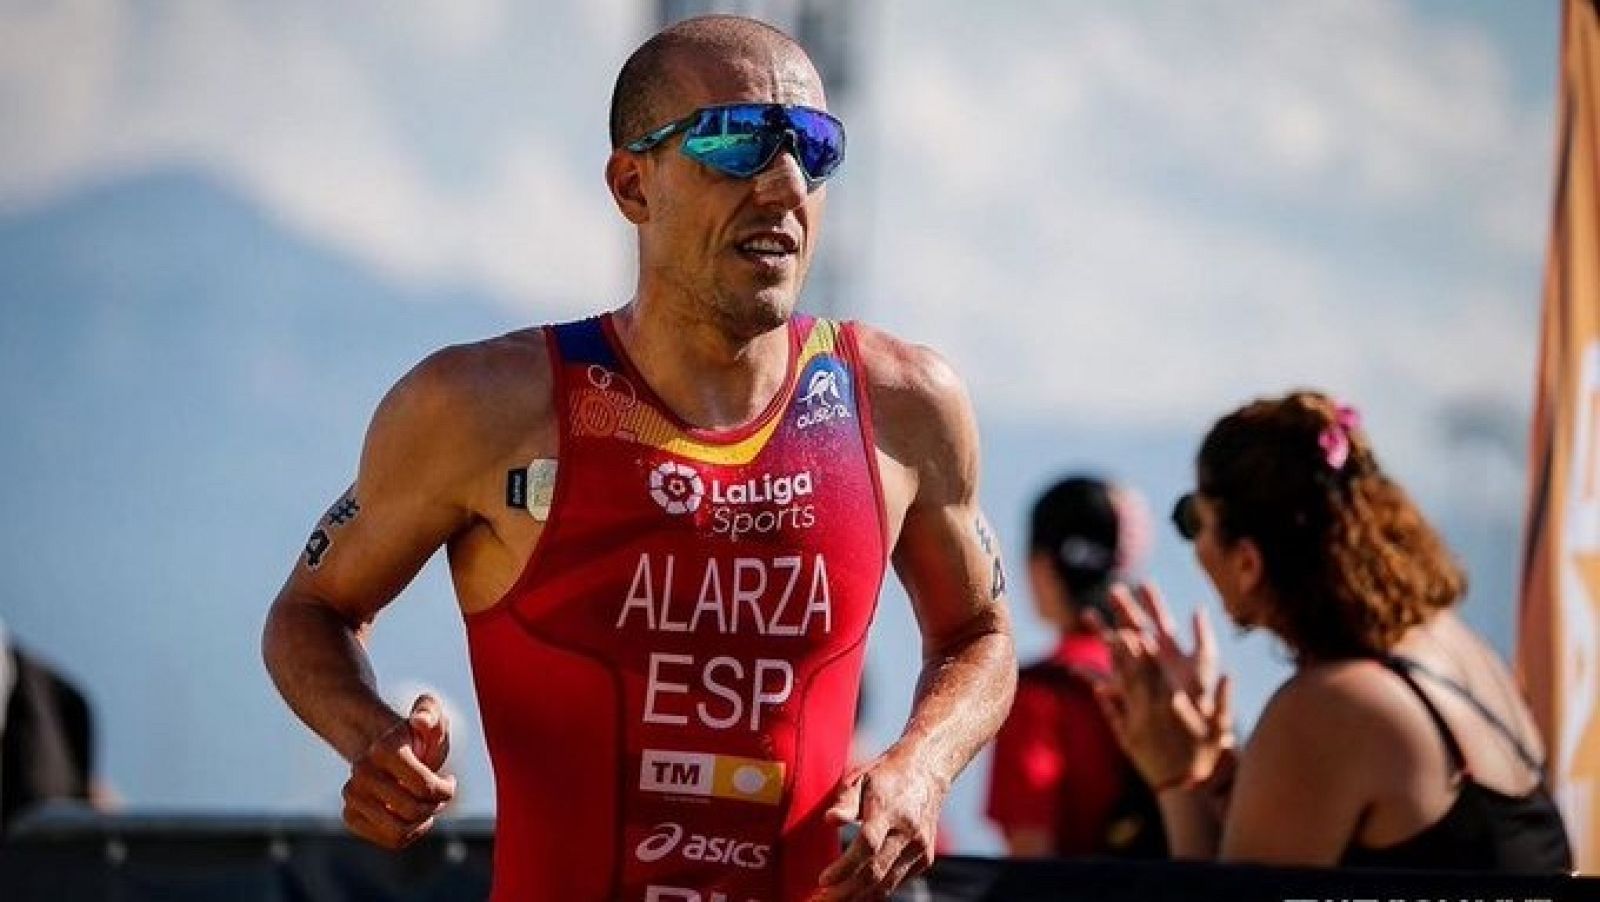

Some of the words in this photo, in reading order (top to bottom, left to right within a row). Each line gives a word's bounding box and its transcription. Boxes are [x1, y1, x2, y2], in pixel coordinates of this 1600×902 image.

[712, 470, 813, 505] LaLiga
[712, 503, 815, 542] Sports
[616, 552, 832, 636] ALARZA
[642, 651, 795, 731] ESP
[651, 761, 701, 786] TM
[682, 834, 771, 870] asics
